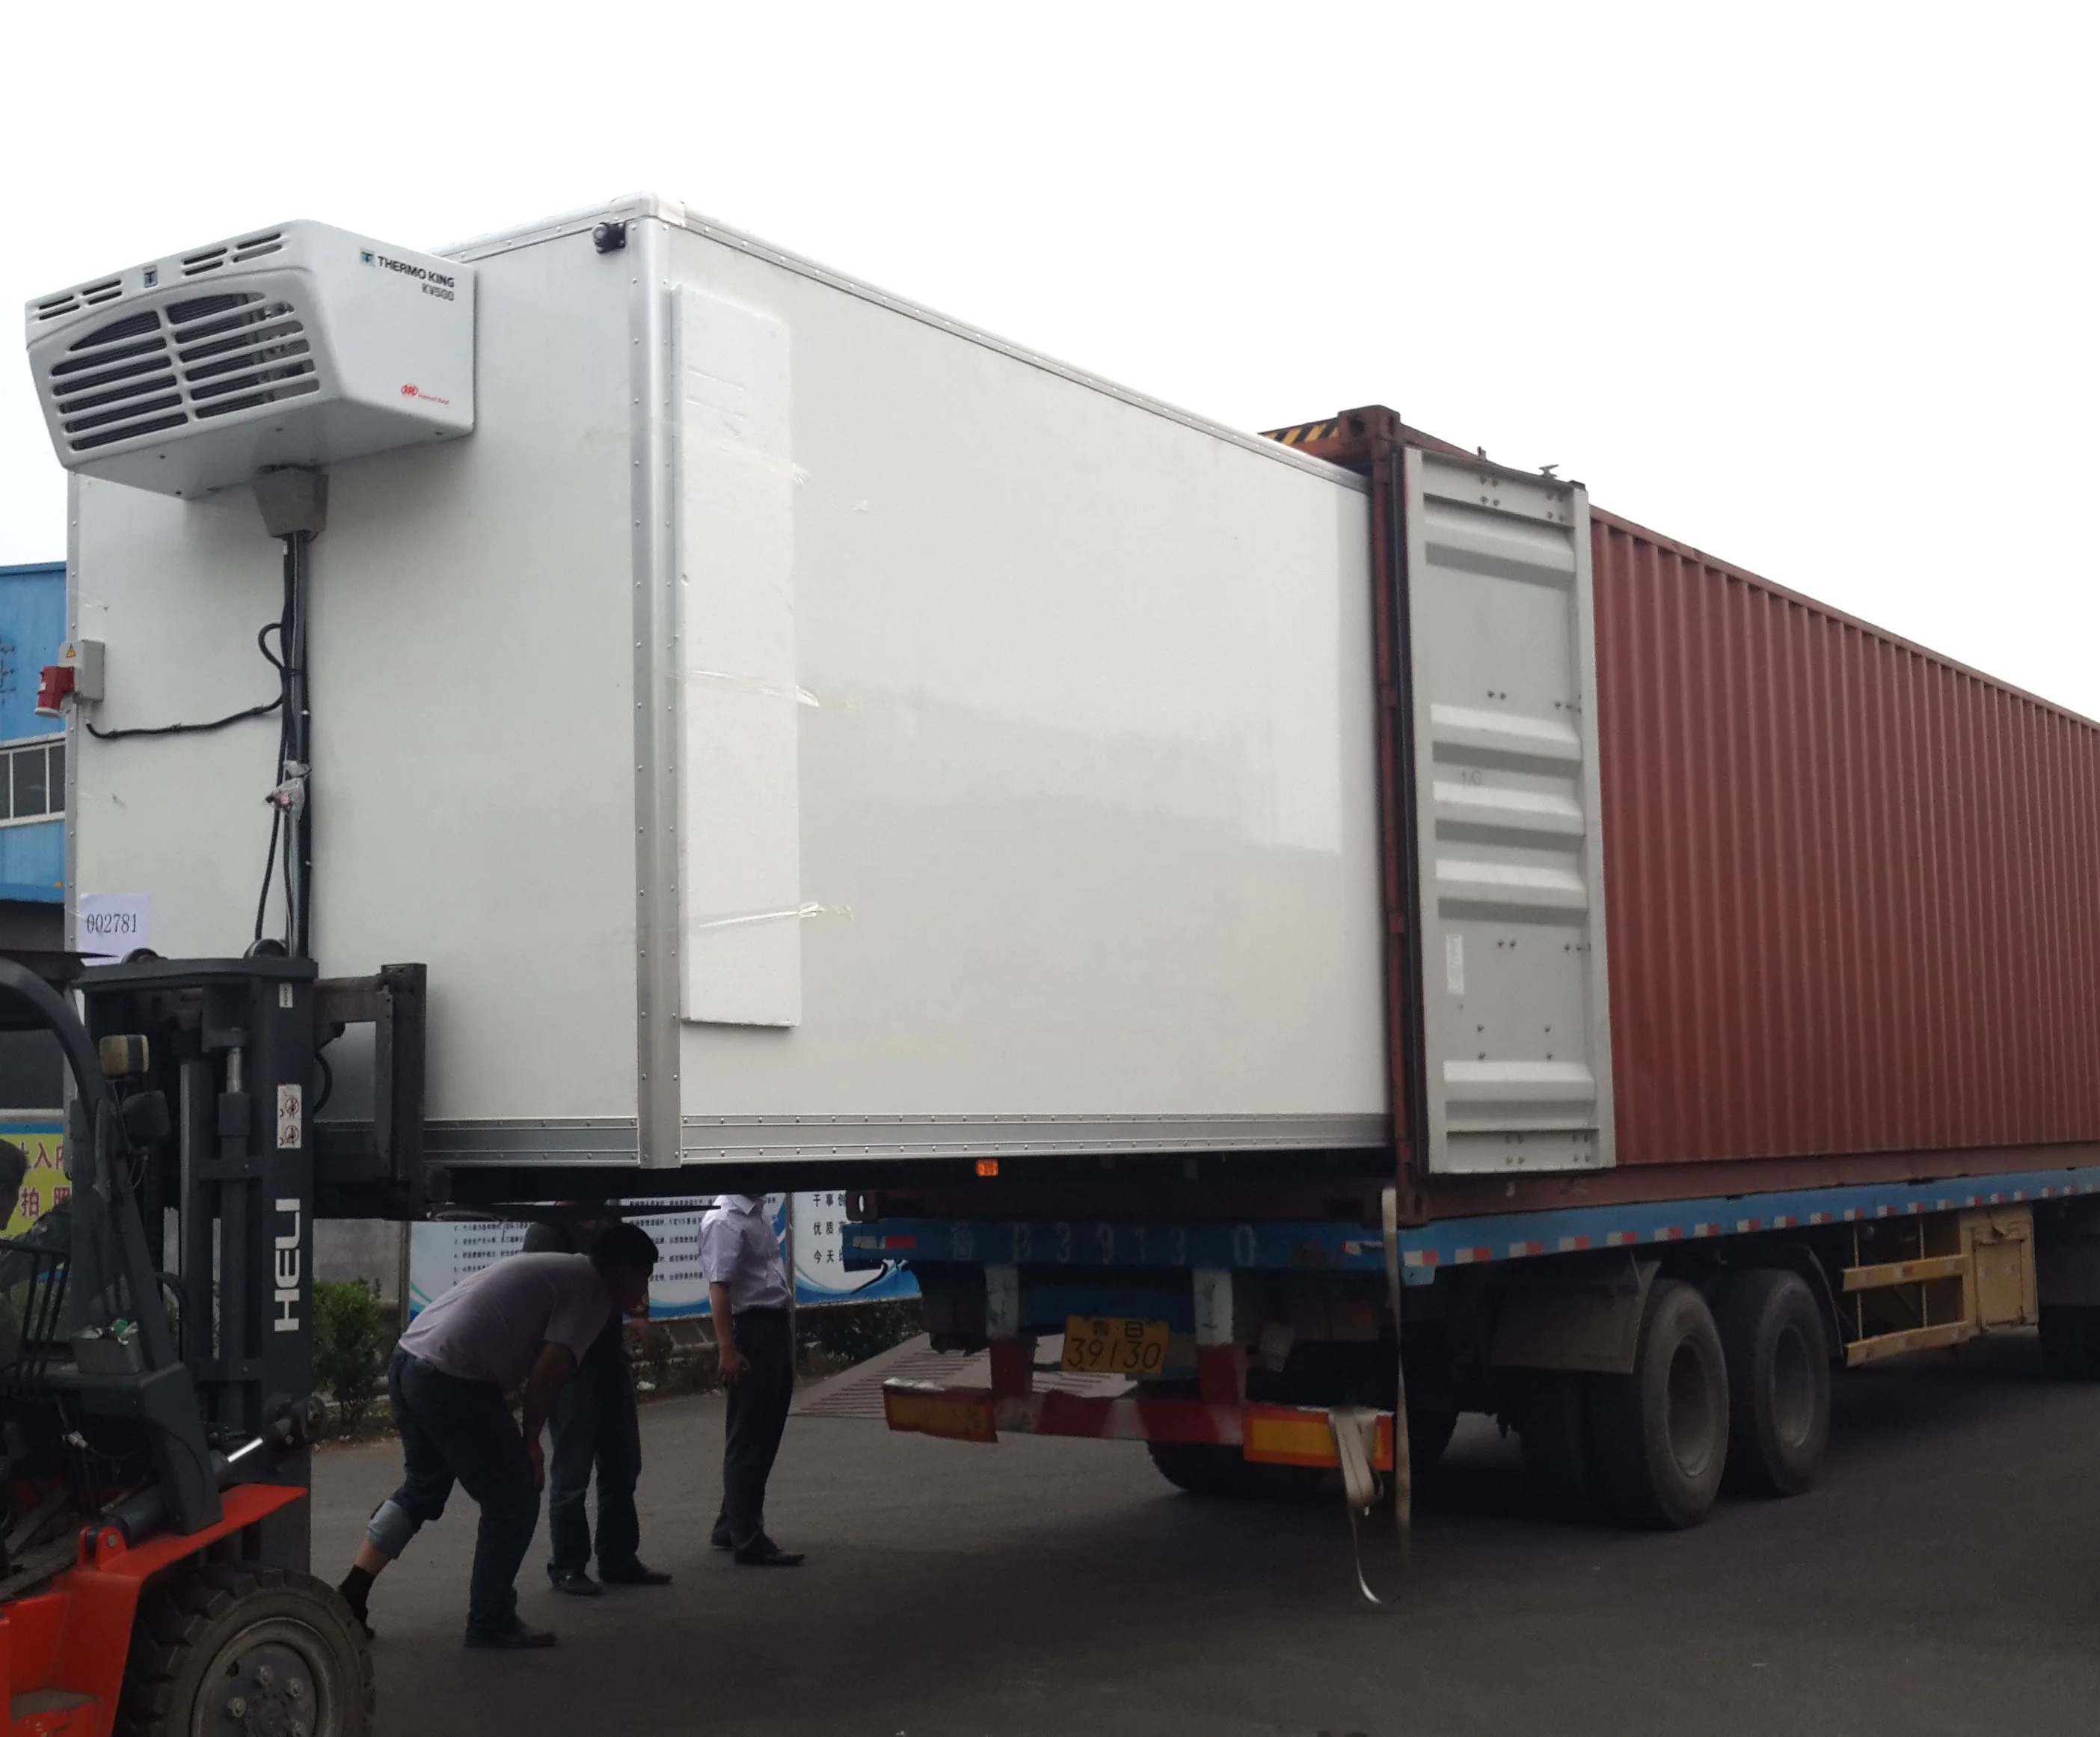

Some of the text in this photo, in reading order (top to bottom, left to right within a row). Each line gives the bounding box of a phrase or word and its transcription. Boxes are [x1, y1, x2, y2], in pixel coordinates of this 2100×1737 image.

[377, 255, 427, 280] THERMO
[428, 271, 455, 288] KING
[87, 913, 137, 934] 002781
[274, 1198, 301, 1332] HELI
[1067, 1337, 1161, 1369] 39130
